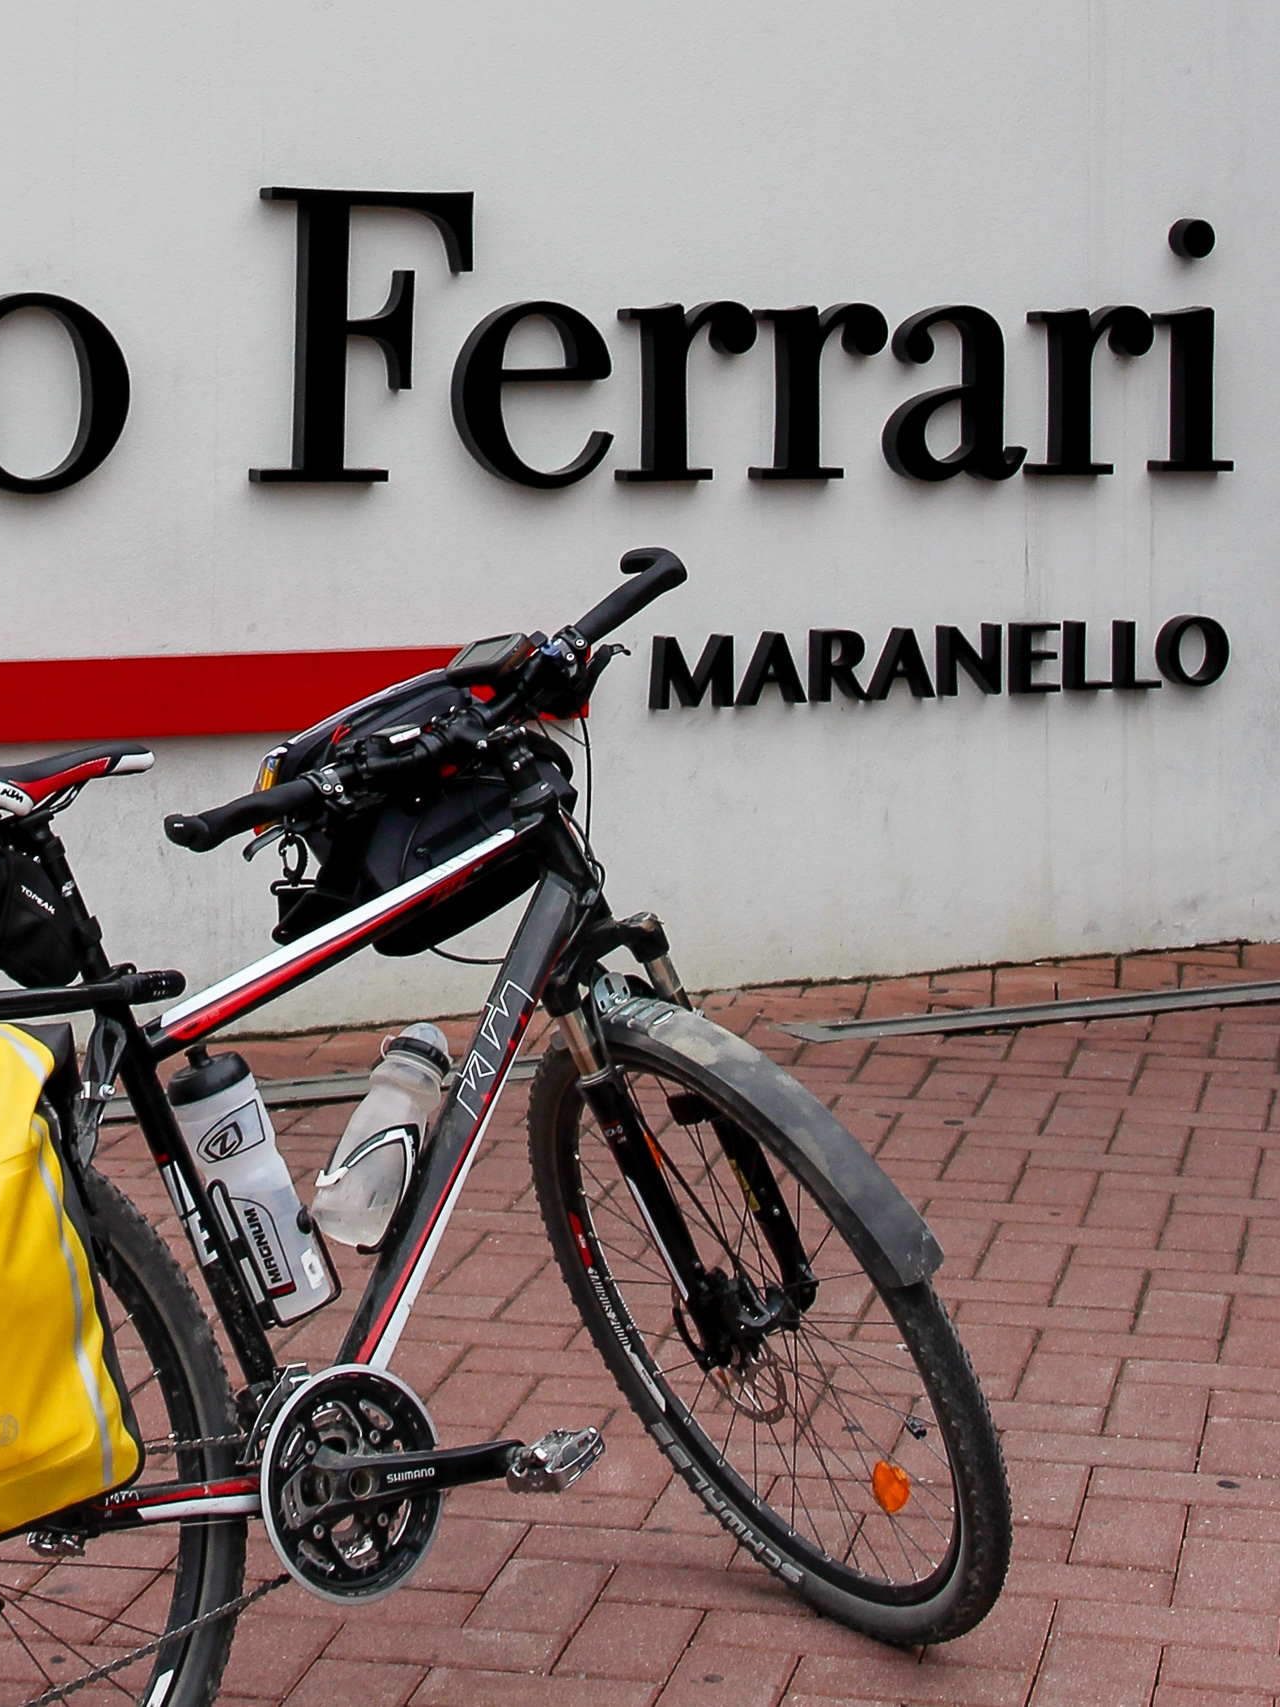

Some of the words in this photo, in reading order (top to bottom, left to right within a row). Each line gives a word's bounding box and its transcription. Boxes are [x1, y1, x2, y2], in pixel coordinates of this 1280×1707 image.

[249, 185, 1234, 489] Ferrari
[648, 614, 1231, 710] MARANELLO
[0, 788, 24, 803] KTM
[20, 884, 56, 915] TOPEAK
[243, 1207, 283, 1285] MAGNUM
[386, 1466, 436, 1484] SHIMANO
[650, 1422, 804, 1584] SCHWALBE
